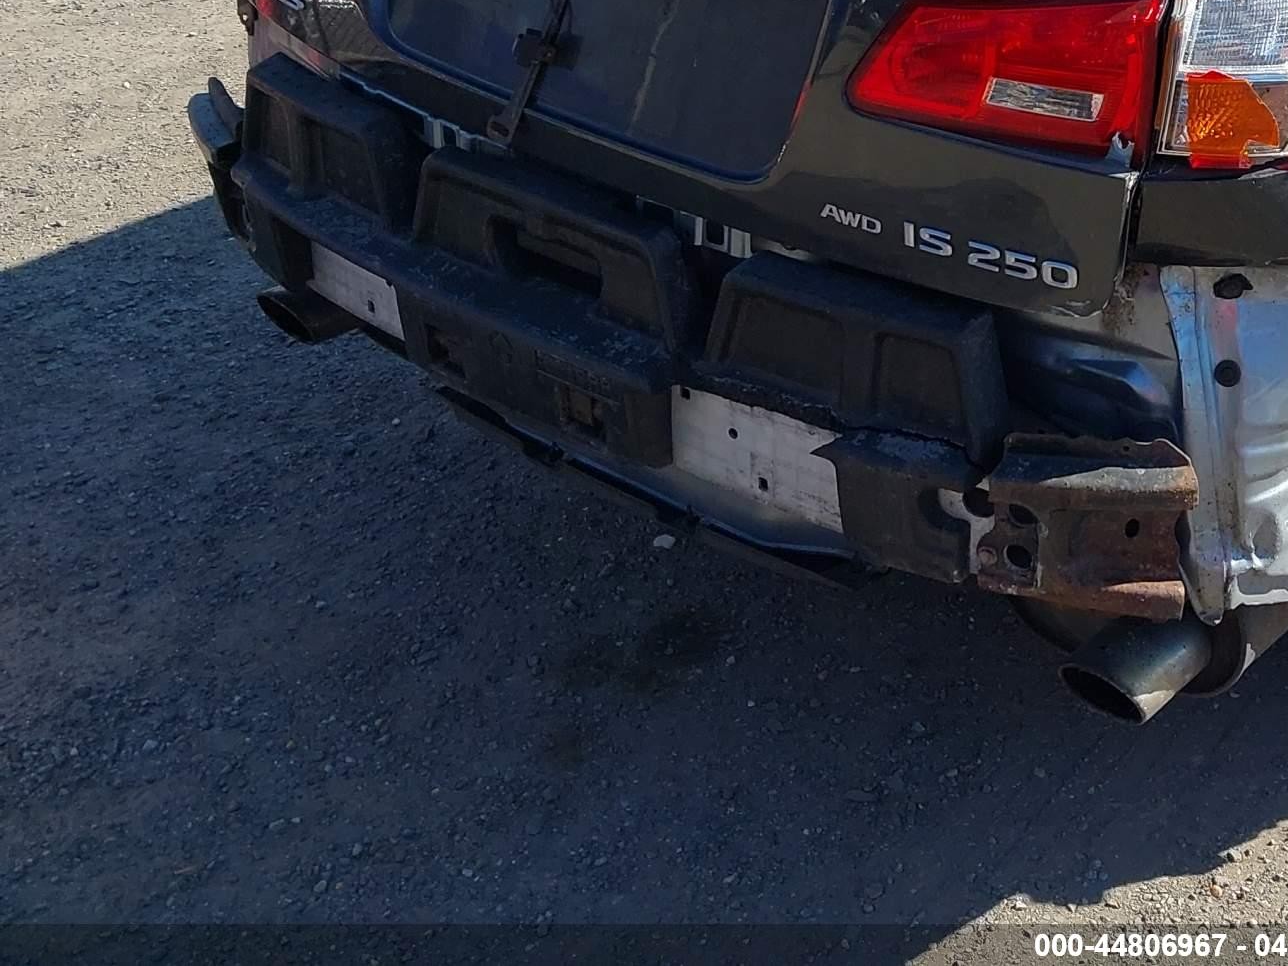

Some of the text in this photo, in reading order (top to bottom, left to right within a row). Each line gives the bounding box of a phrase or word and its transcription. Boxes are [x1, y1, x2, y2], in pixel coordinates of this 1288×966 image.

[820, 203, 1079, 290] AWD IS 250
